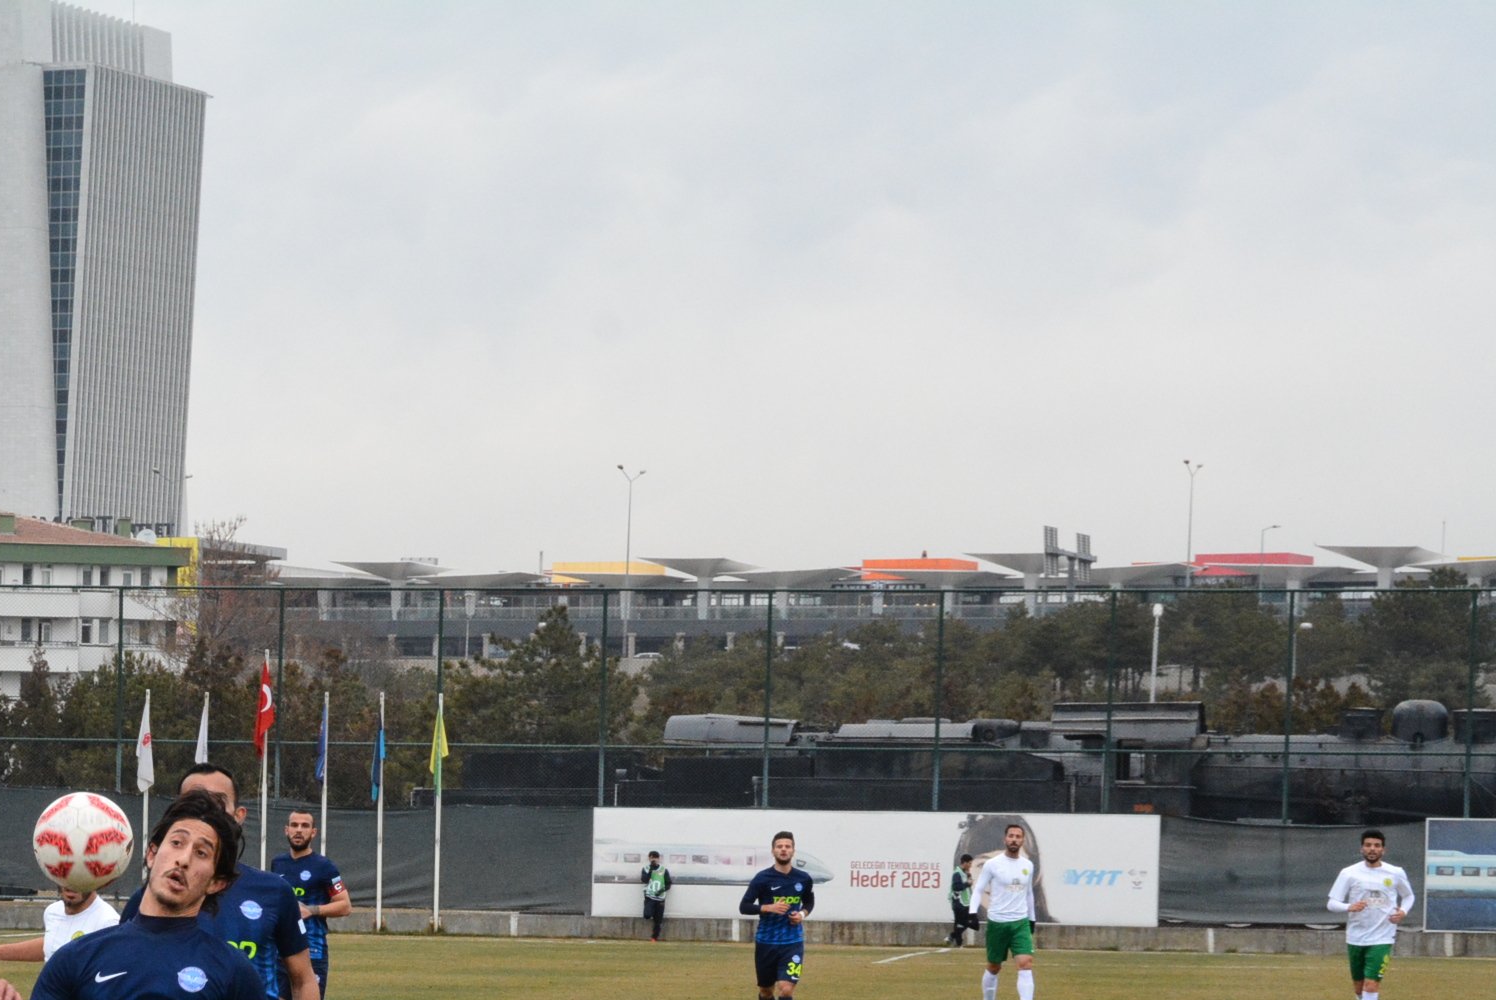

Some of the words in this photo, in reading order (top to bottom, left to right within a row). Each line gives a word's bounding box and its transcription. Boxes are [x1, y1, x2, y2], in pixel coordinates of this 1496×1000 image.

[850, 870, 897, 888] Hedef
[901, 871, 941, 889] 2023
[1063, 869, 1123, 886] YHT
[773, 896, 801, 905] TDD
[786, 961, 803, 977] 34
